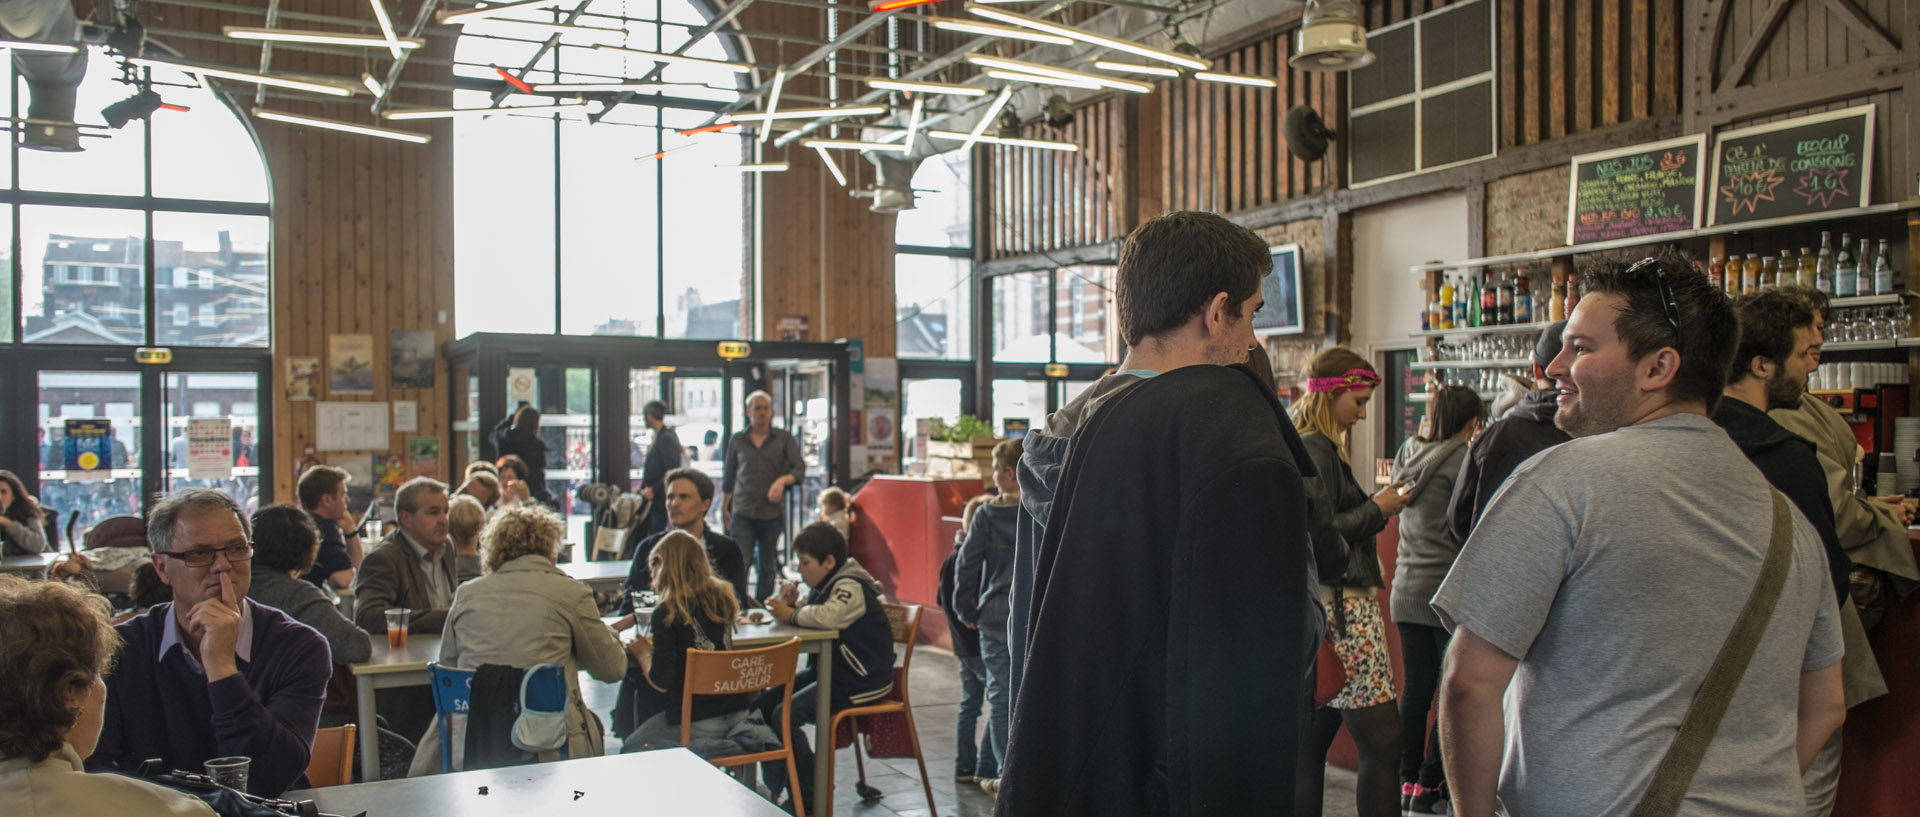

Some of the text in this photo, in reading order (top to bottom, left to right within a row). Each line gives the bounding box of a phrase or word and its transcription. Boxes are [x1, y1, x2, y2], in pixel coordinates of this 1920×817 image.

[1725, 145, 1748, 162] CB
[1596, 158, 1622, 177] NOS
[1626, 154, 1654, 172] JUS
[1723, 156, 1787, 176] PARTIR DE
[1790, 153, 1856, 173] CONSIGNE
[1734, 179, 1767, 195] 10 €
[1811, 172, 1837, 192] 1 €
[731, 655, 765, 669] GARE
[740, 663, 774, 679] SAINT
[713, 675, 771, 692] SAUVEUR
